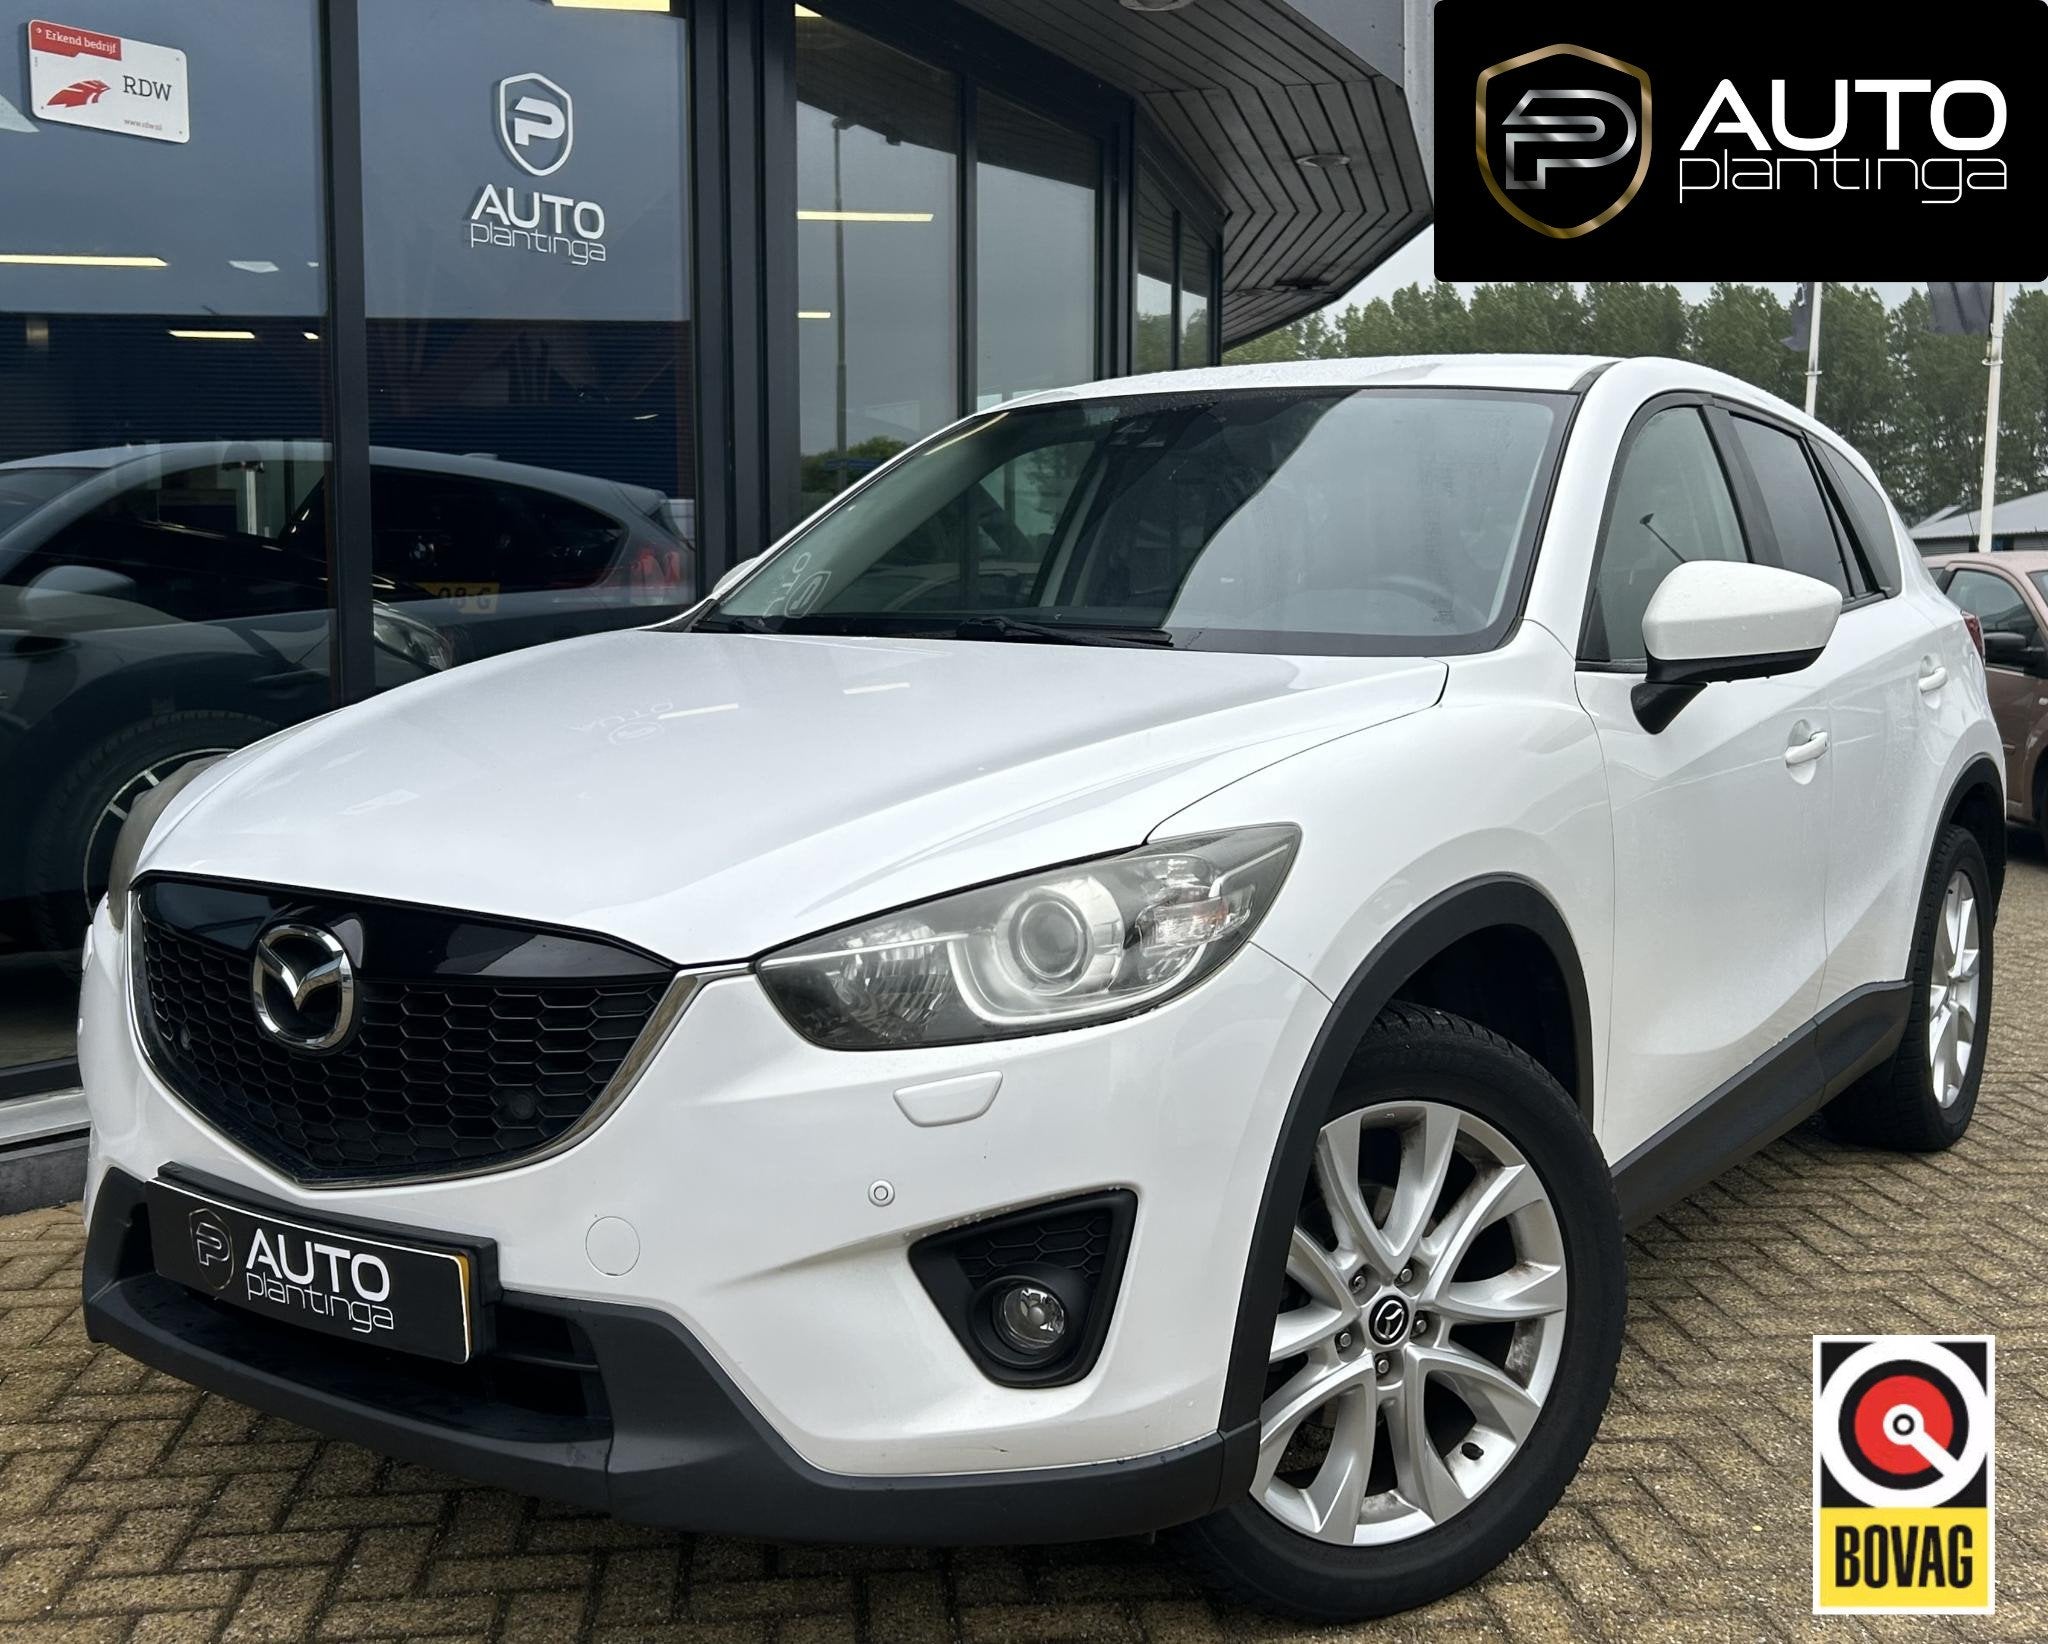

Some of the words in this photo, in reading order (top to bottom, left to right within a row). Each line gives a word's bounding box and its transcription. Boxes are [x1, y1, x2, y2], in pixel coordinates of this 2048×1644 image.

[45, 29, 82, 46] Erkend
[84, 37, 117, 55] bedrijf
[122, 75, 173, 102] RDW
[471, 183, 605, 240] AUTO
[470, 221, 606, 266] plantinga
[246, 1227, 391, 1303] AUTO
[246, 1271, 394, 1334] plantinga
